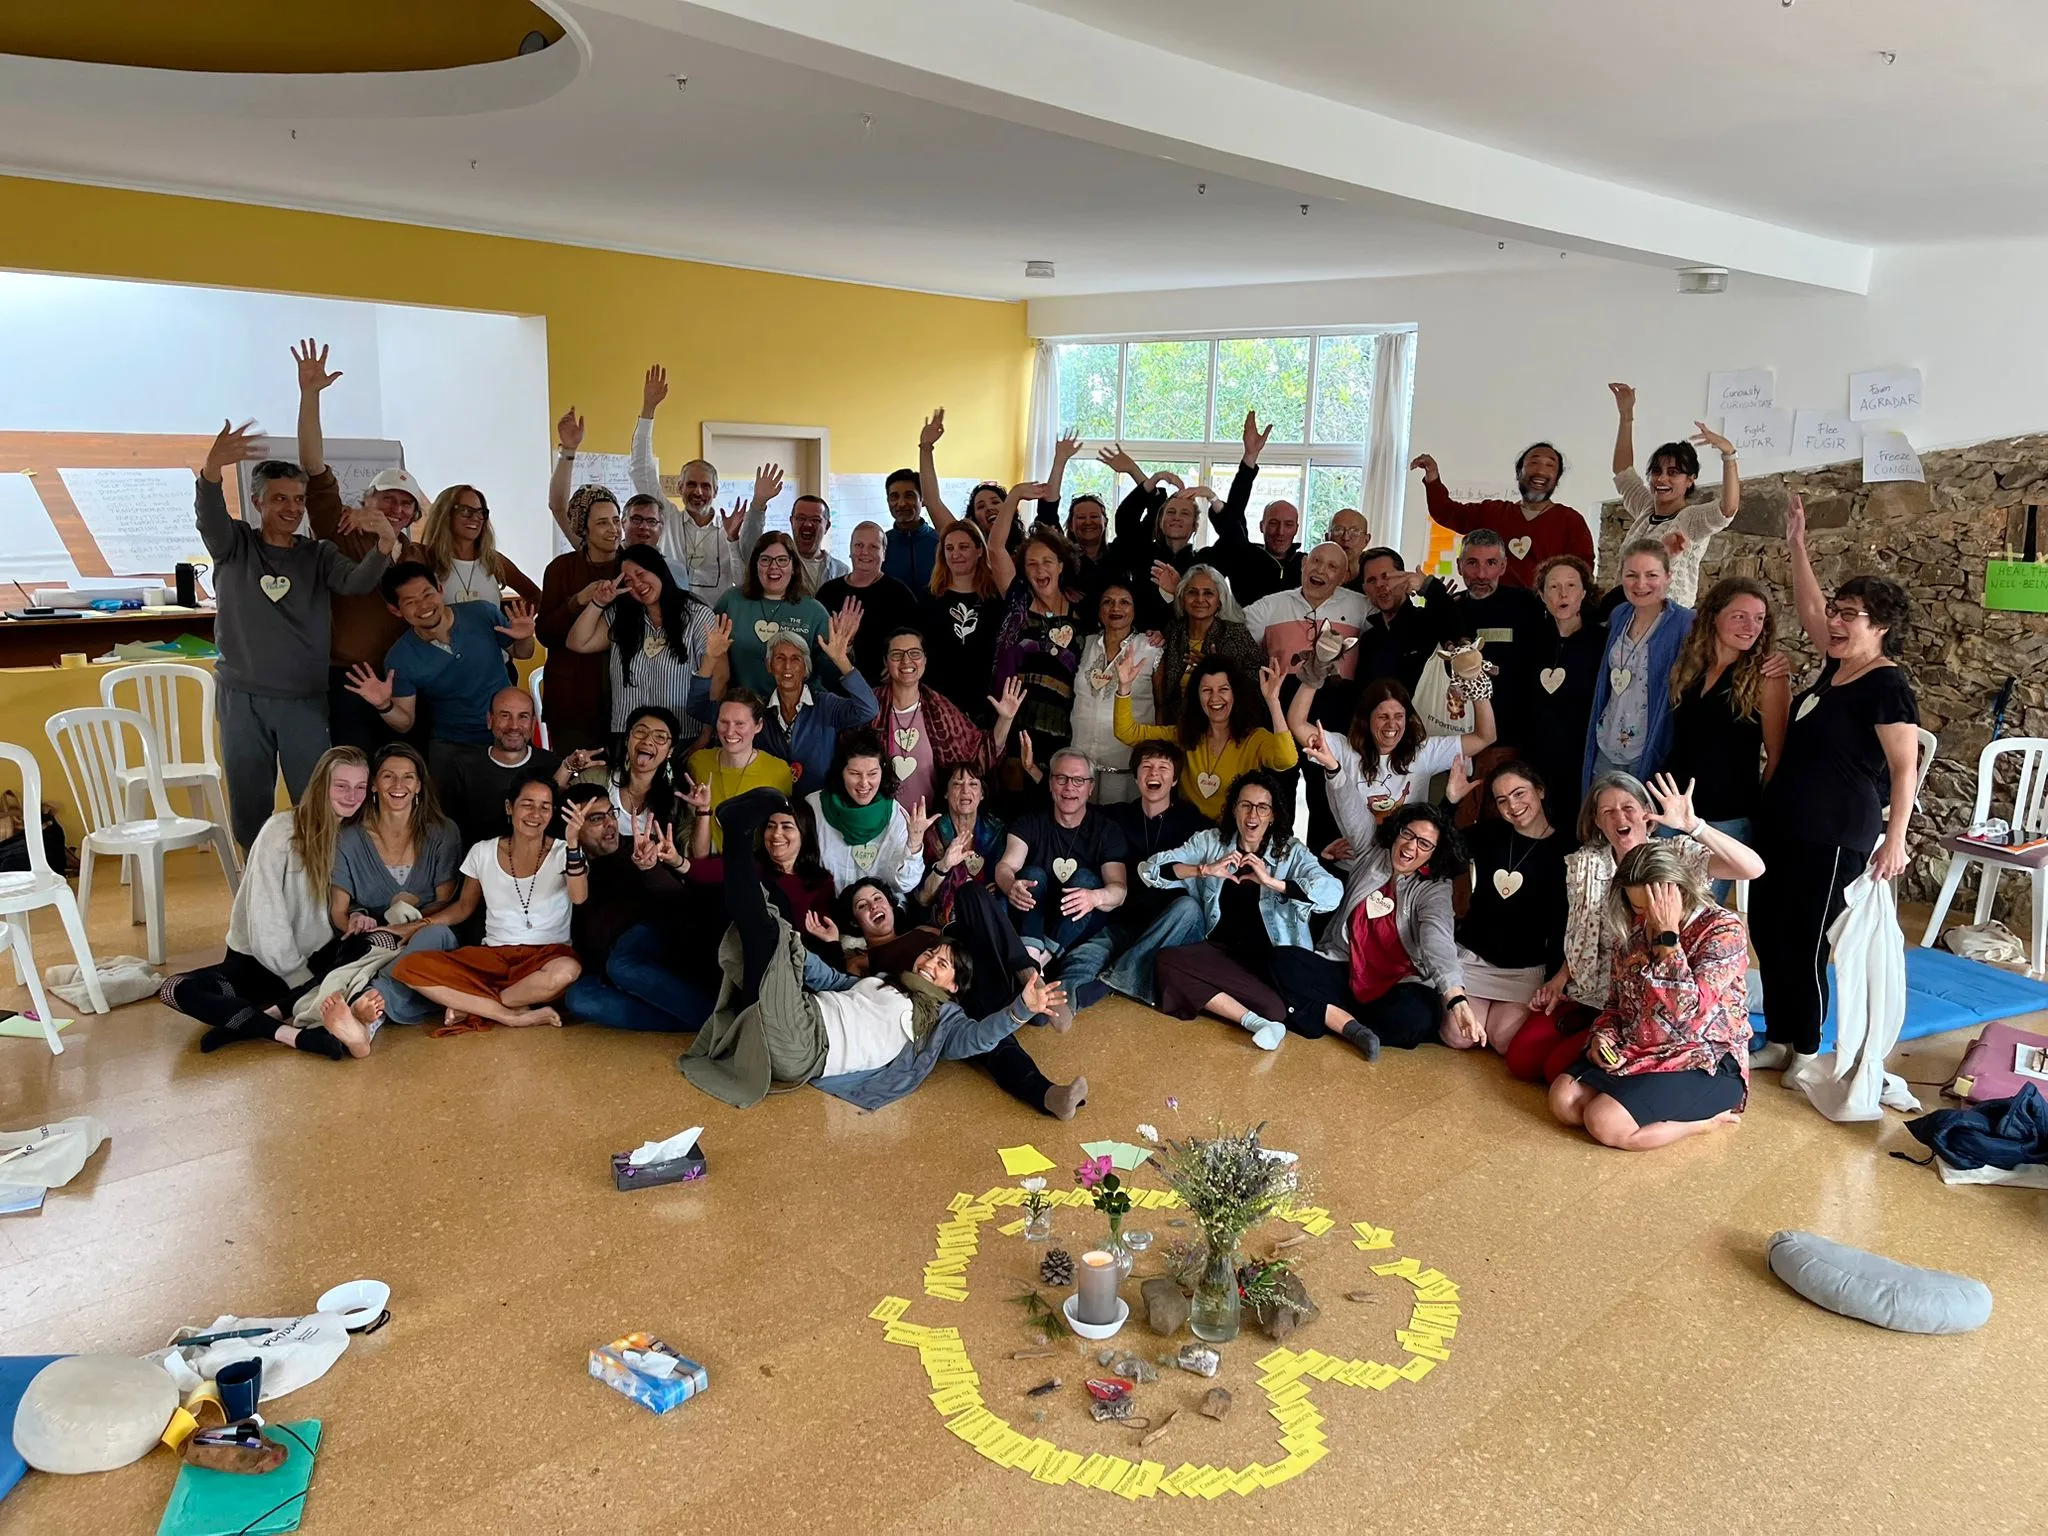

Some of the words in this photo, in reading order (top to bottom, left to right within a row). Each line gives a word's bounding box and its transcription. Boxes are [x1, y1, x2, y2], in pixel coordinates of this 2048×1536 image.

[1860, 394, 1920, 412] AGRADAR
[1744, 422, 1767, 438] Fight
[1818, 422, 1839, 435] Flee
[1736, 437, 1775, 449] LUTAR
[1804, 436, 1847, 451] FUGIR
[1879, 450, 1911, 462] Freeze
[1990, 579, 2048, 590] WELL-BEIN
